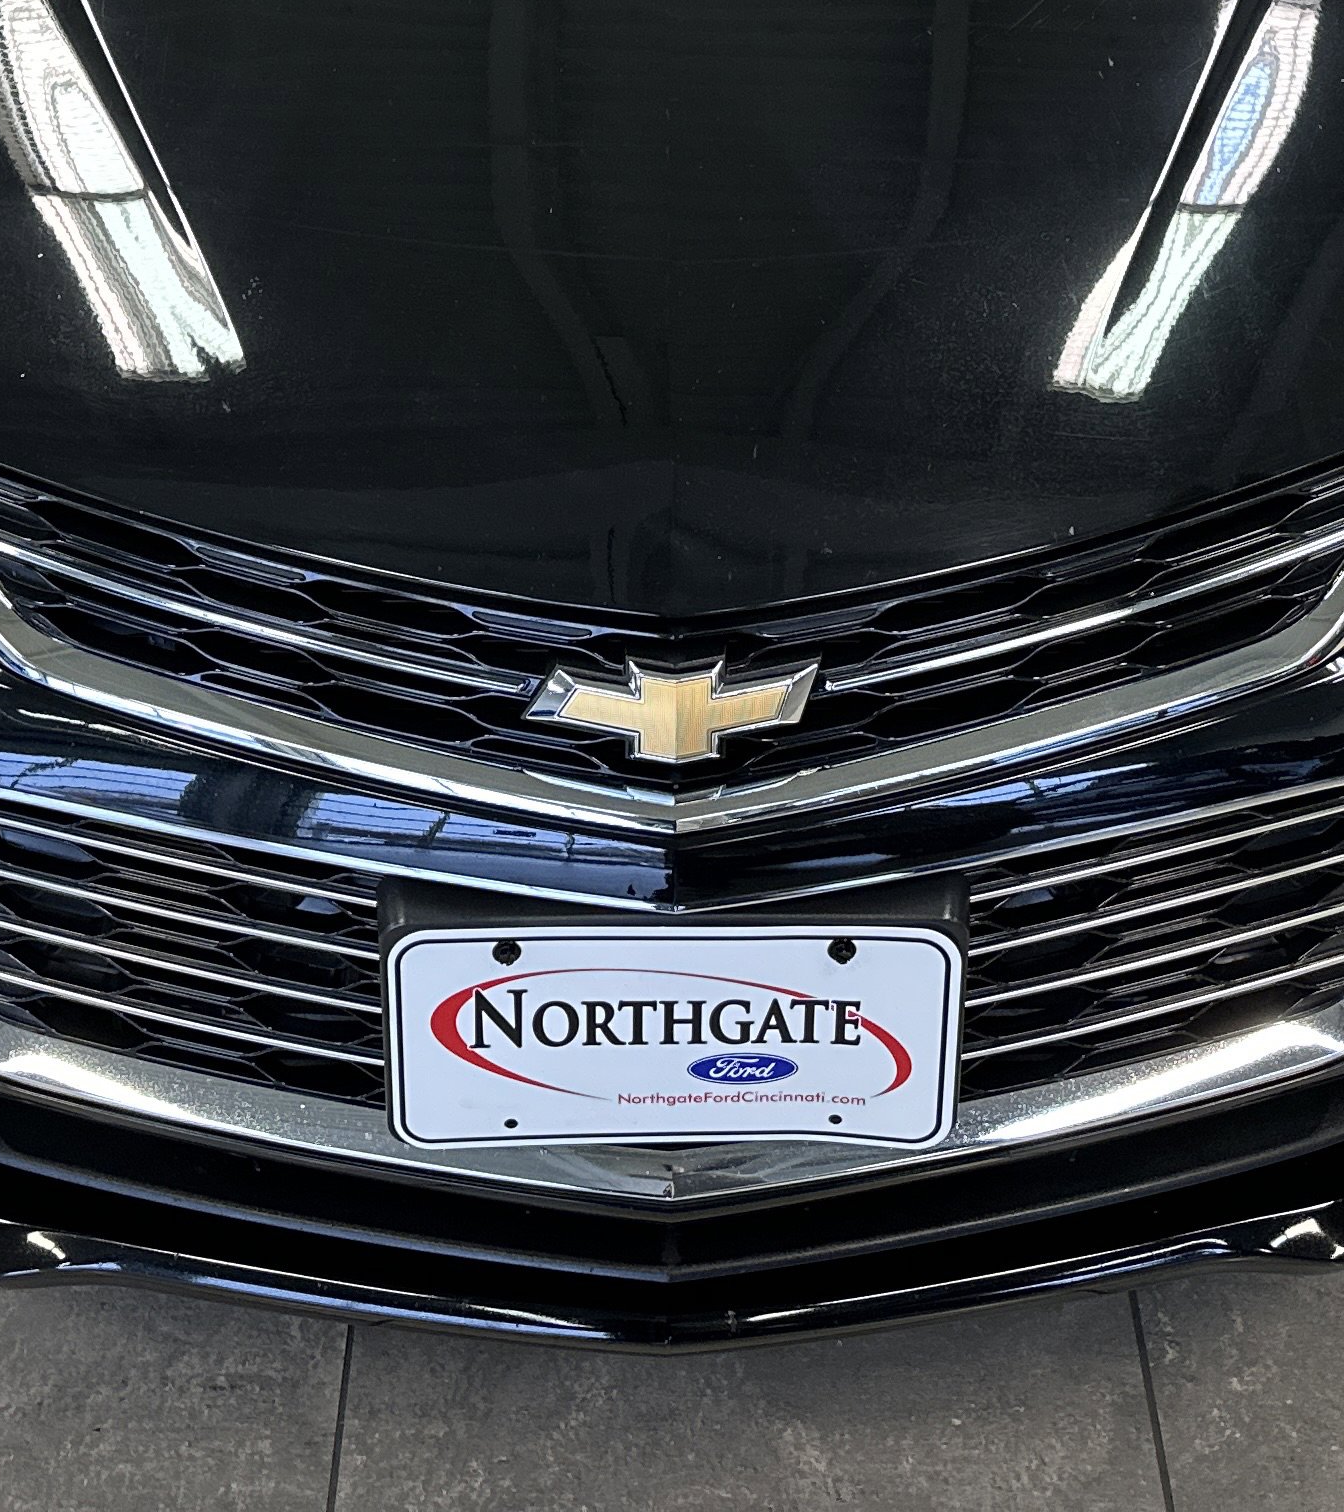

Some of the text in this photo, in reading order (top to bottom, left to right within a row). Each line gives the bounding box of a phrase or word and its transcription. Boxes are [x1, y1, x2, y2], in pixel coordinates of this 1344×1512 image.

[468, 988, 862, 1050] NORTHGATE
[708, 1056, 775, 1080] Ford
[617, 1092, 866, 1107] NorthgateFordCincinnati.com
